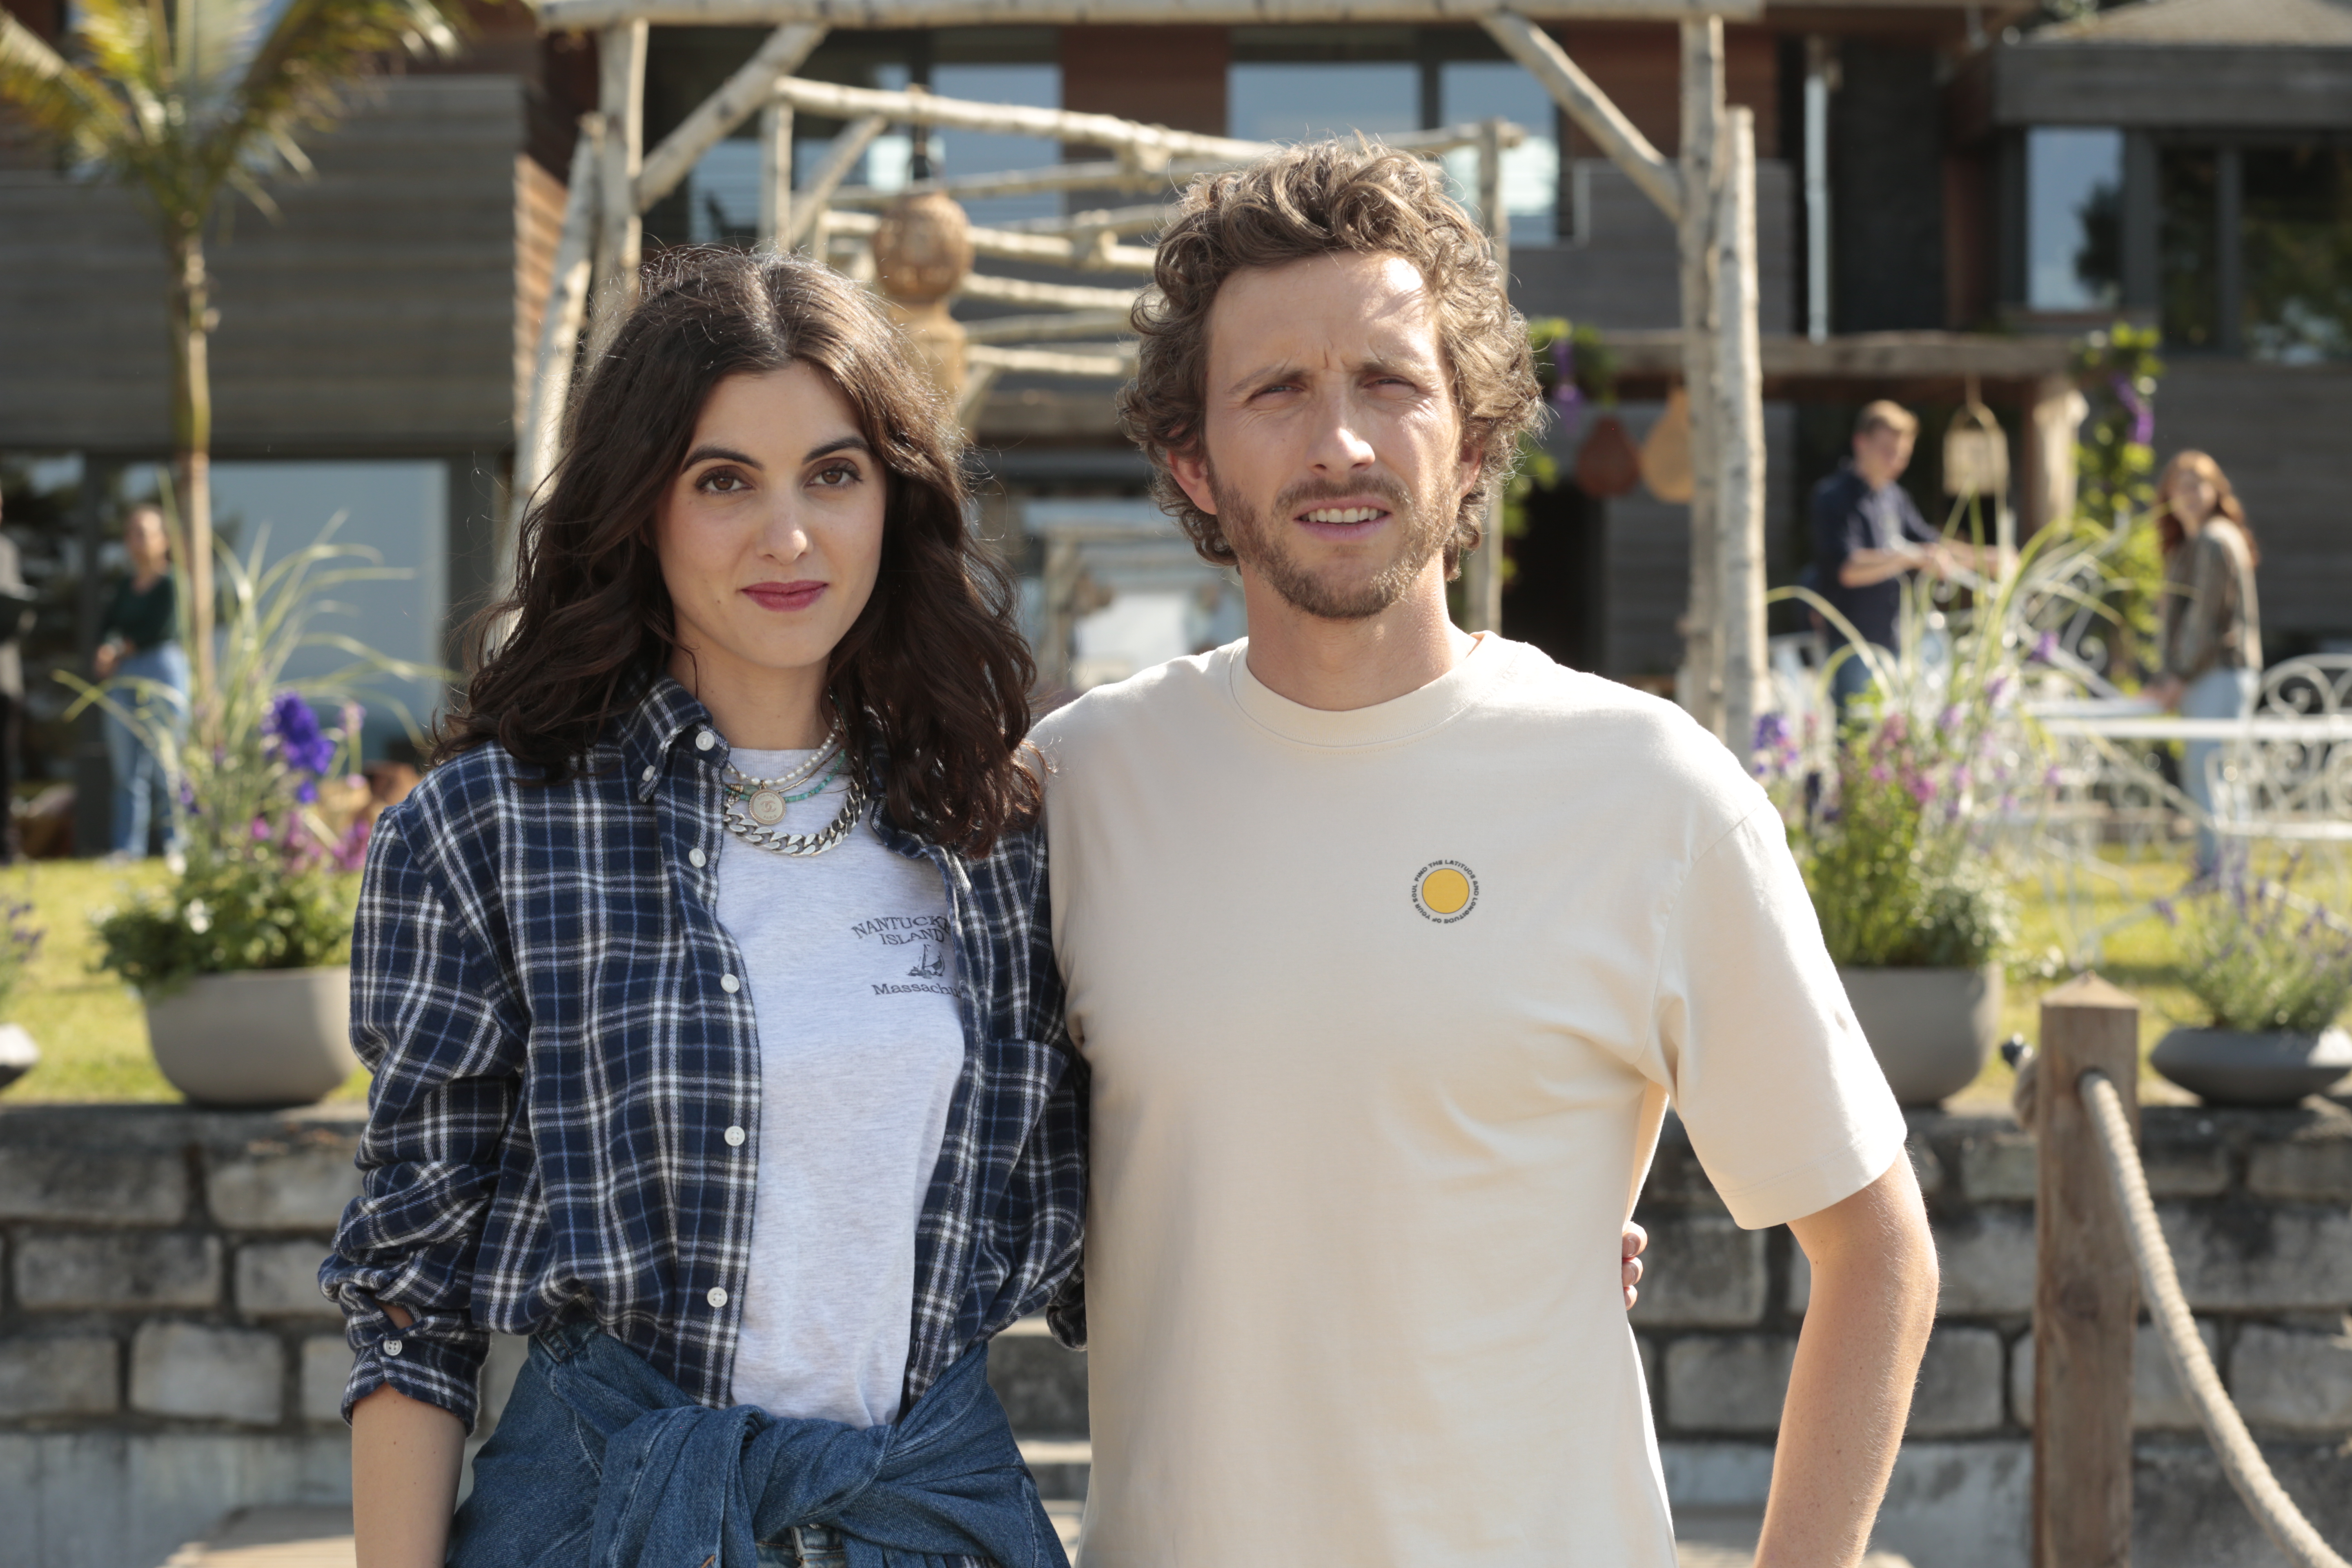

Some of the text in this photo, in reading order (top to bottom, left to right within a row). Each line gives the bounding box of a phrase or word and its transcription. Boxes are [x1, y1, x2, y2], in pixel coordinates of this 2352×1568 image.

[1428, 860, 1443, 868] THE
[1445, 860, 1476, 879] LATITUDE
[1414, 866, 1428, 882] FIND
[1415, 903, 1430, 920] YOUR
[1443, 897, 1478, 924] LONGITUDE
[879, 928, 944, 944] ISLAND
[871, 983, 961, 999] Massachu
